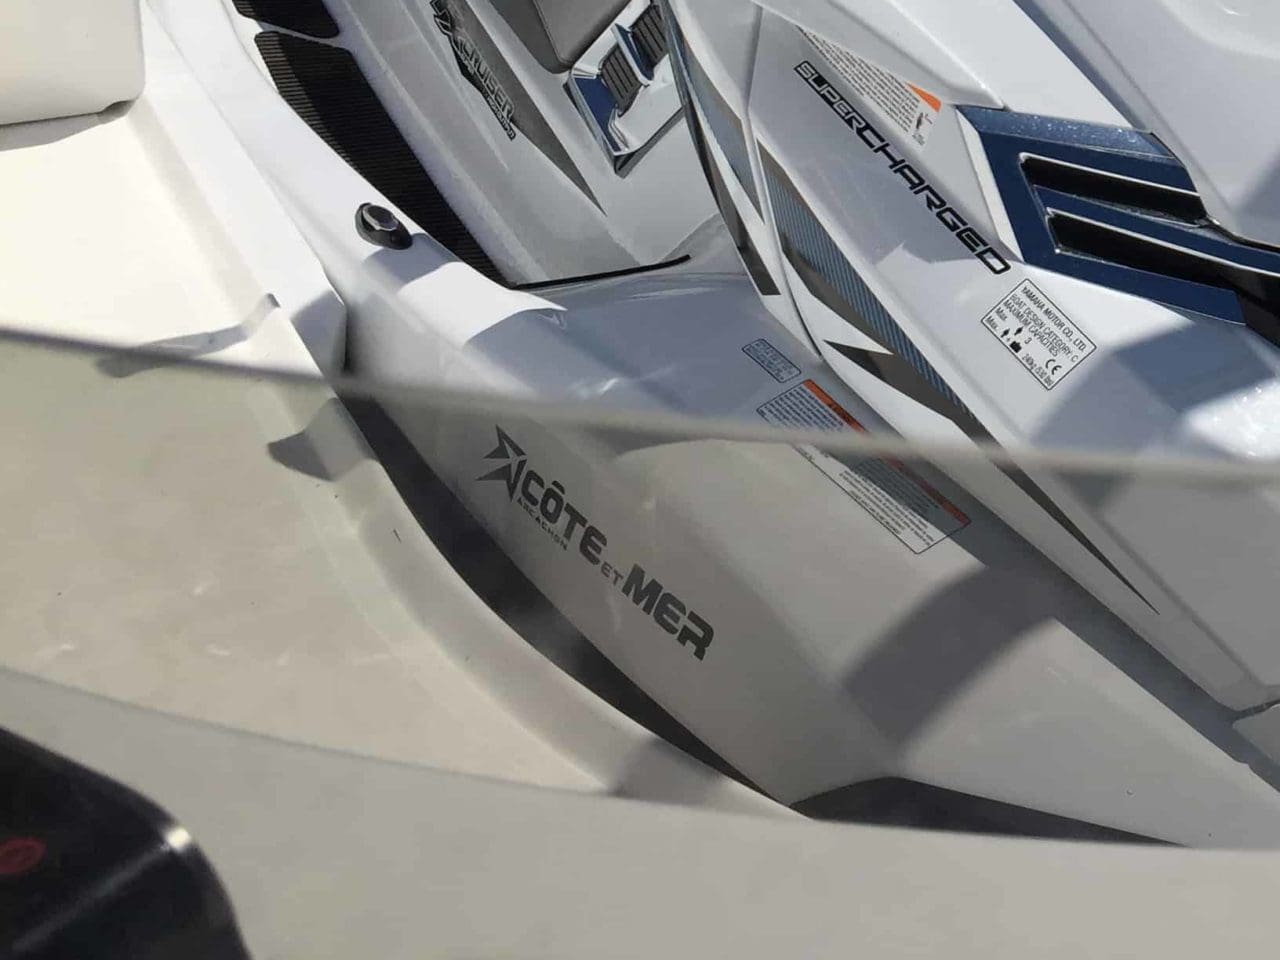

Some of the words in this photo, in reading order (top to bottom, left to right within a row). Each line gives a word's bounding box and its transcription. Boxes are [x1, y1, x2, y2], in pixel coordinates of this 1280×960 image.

[460, 29, 515, 121] CRUISER
[793, 60, 1011, 275] SUPERCHARGED
[1003, 300, 1031, 326] MAXIMUM
[1028, 325, 1060, 357] CAPACITIES
[1021, 286, 1046, 310] YAMAHA
[1044, 308, 1065, 330] MOTOR
[1023, 308, 1045, 329] DESIGN
[516, 496, 569, 552] ARCACHON
[520, 469, 608, 566] CÔTE
[600, 560, 625, 586] ET
[622, 563, 715, 661] MER
